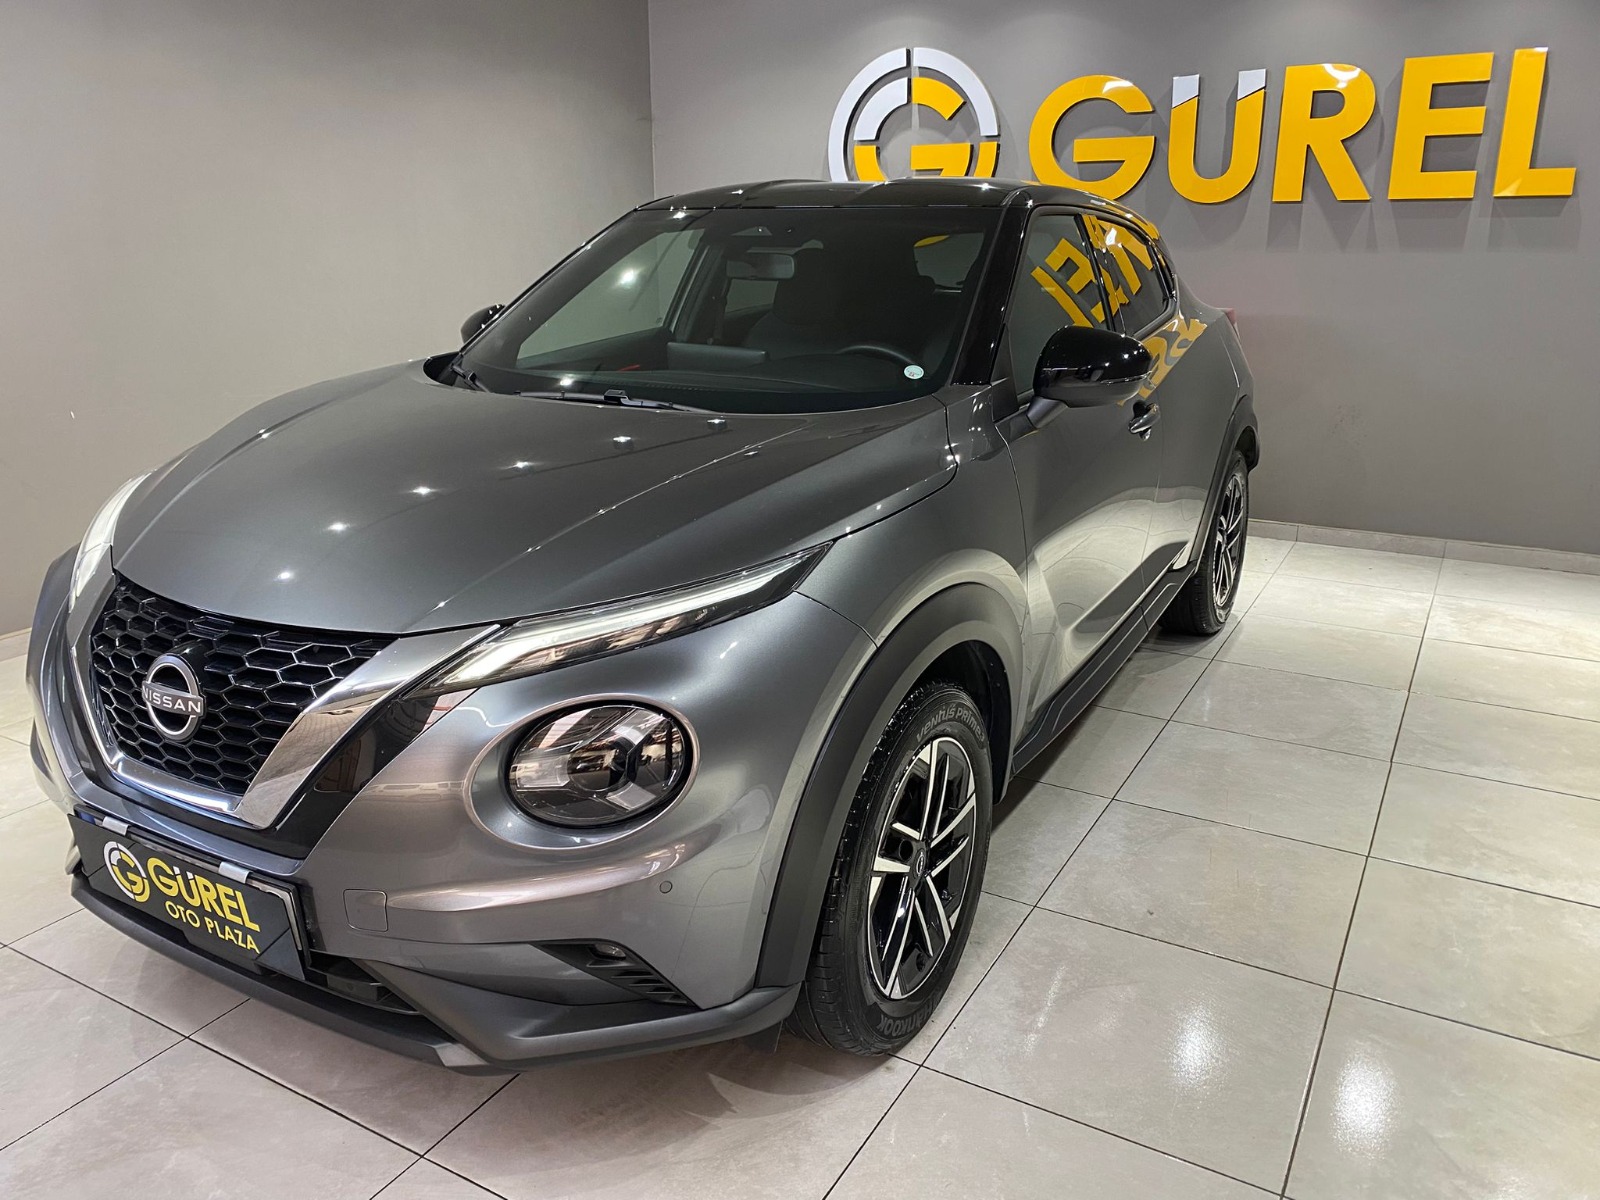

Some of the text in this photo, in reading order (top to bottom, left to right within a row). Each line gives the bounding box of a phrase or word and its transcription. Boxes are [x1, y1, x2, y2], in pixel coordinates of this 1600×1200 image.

[142, 685, 201, 713] NISSAN
[165, 900, 261, 954] OTO PLAZA
